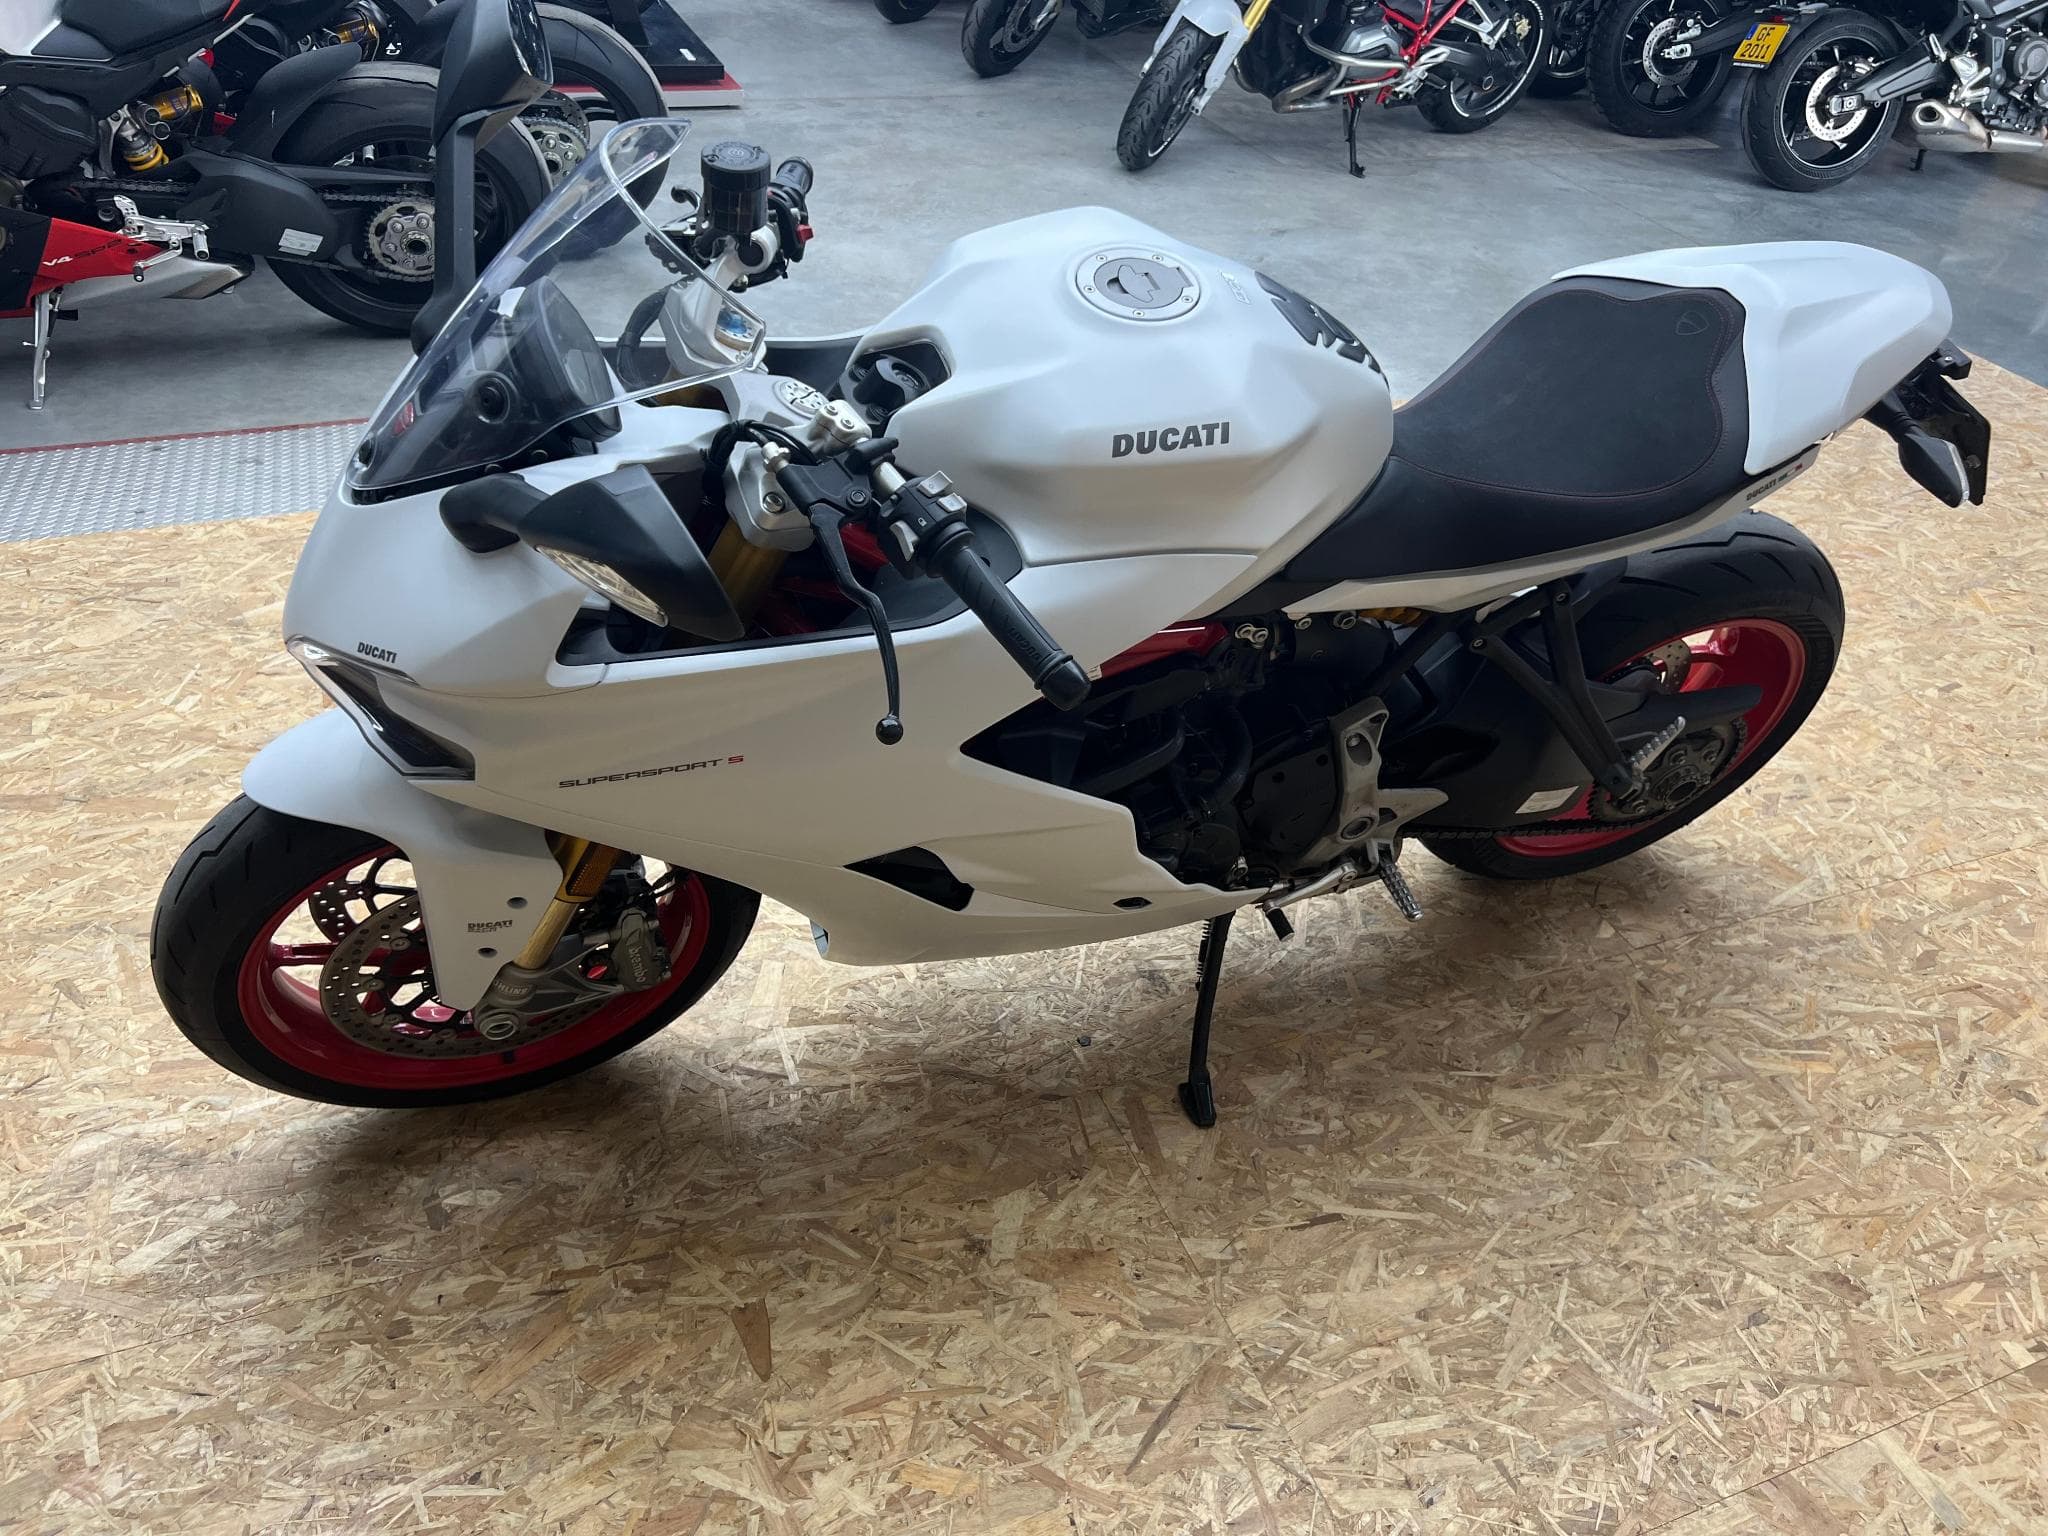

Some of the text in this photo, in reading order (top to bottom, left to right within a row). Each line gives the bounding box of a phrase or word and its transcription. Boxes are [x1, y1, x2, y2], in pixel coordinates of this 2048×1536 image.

[1757, 27, 1775, 41] GF
[1740, 43, 1771, 59] 2011
[43, 256, 74, 266] V4
[1111, 421, 1229, 458] DUCATI
[1746, 479, 1777, 501] DUCATI
[357, 642, 397, 663] DUCATI
[559, 755, 744, 788] SUPERSPORT S
[468, 920, 513, 928] DUCATI
[629, 945, 648, 983] brembo
